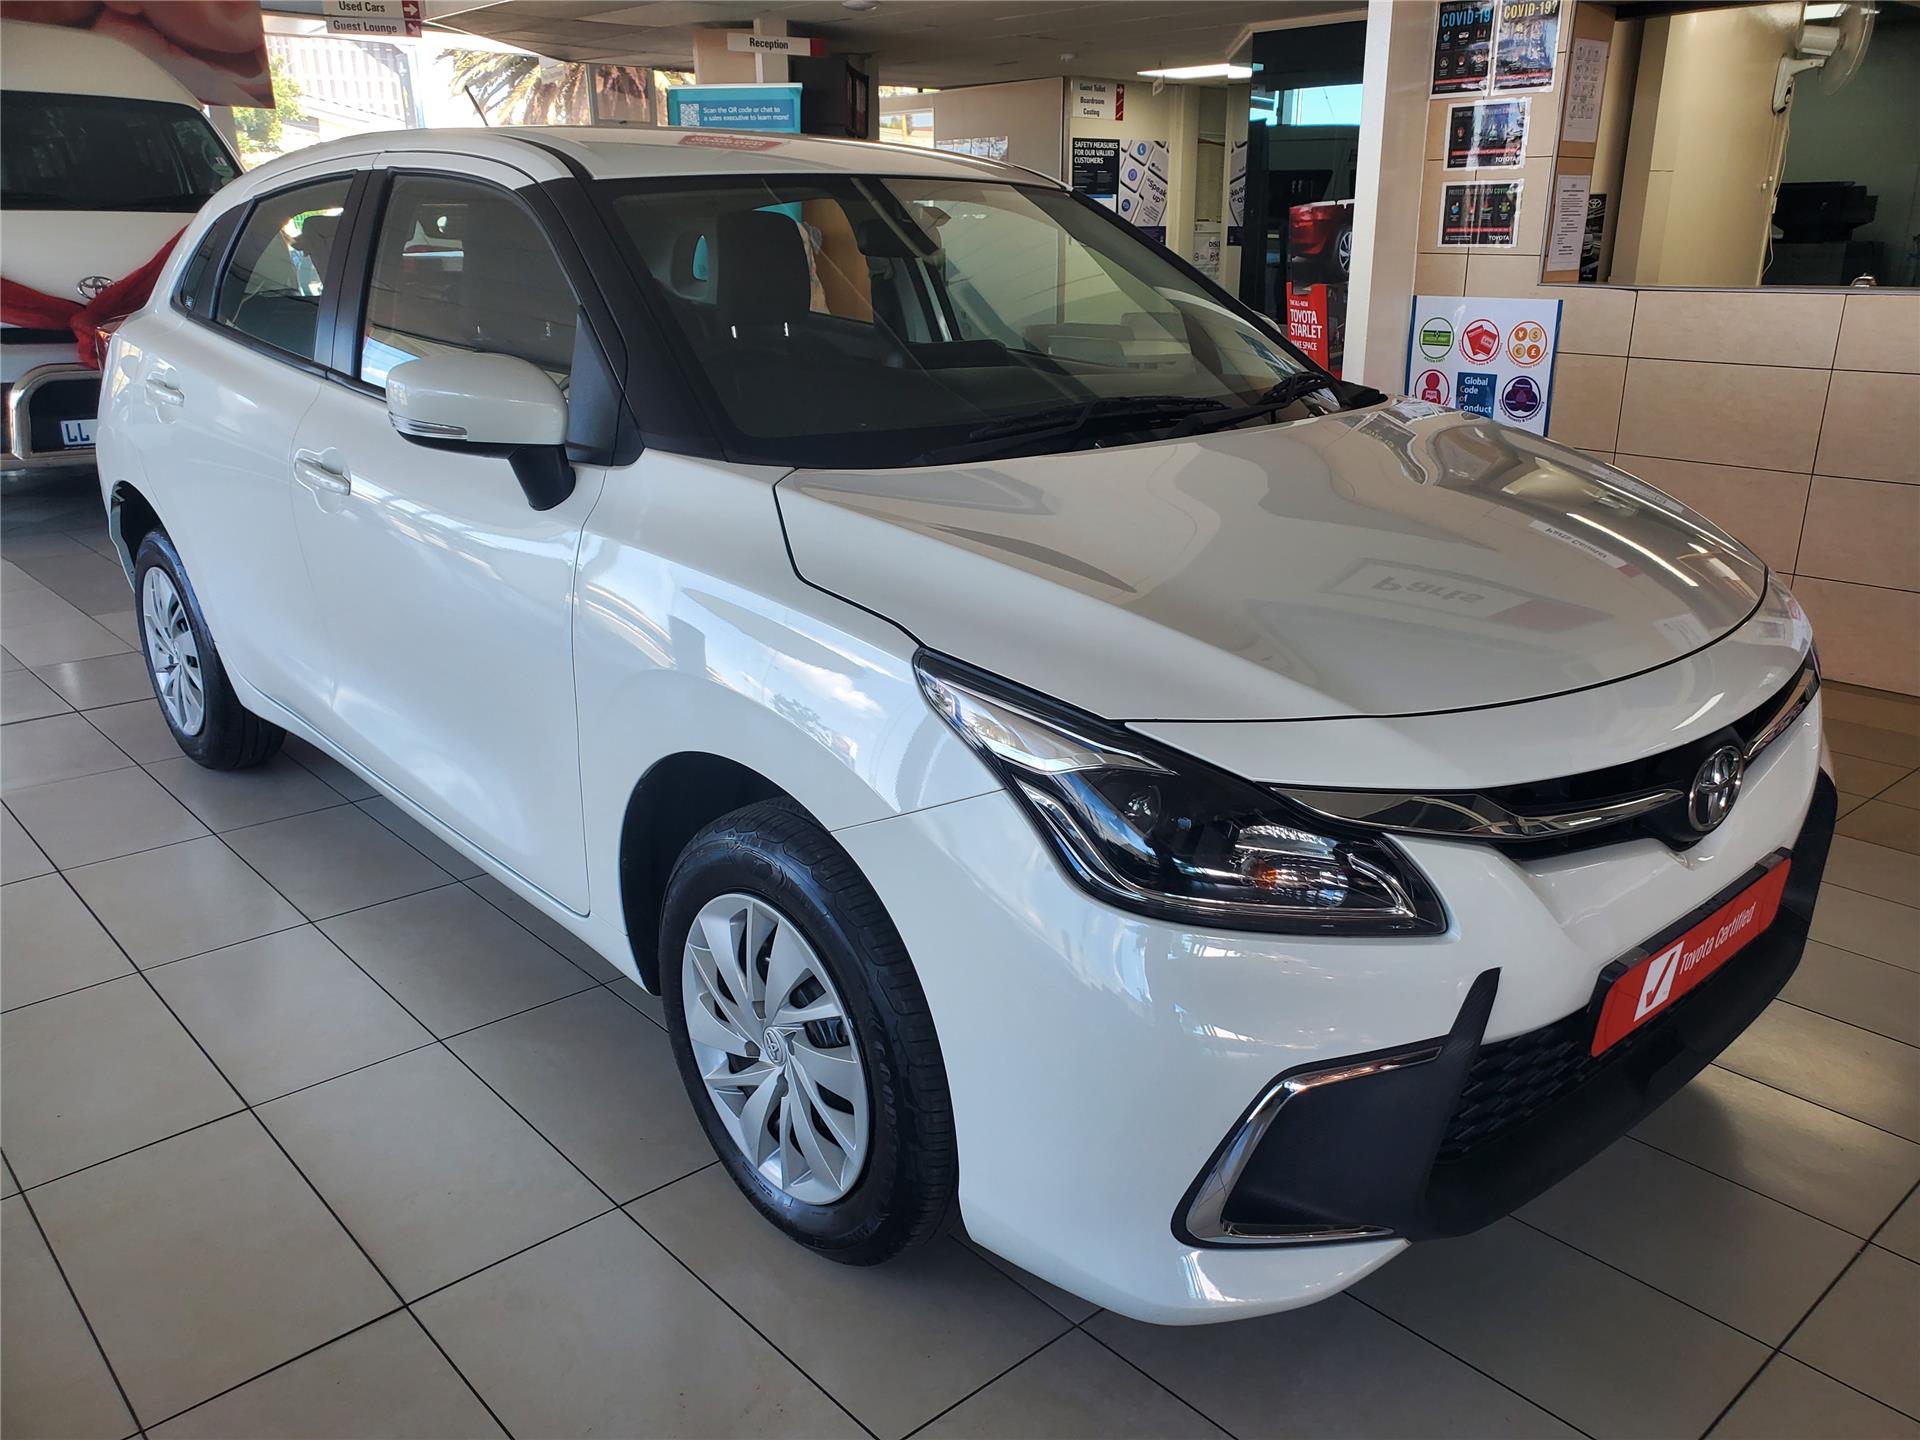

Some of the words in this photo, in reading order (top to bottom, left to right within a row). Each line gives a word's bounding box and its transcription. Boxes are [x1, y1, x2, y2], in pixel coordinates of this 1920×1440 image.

[339, 1, 362, 11] Used
[365, 2, 386, 13] Cars
[1442, 8, 1491, 28] COVID-19
[334, 20, 361, 31] Guest
[364, 22, 398, 34] Lounge
[749, 37, 789, 50] Reception
[1080, 96, 1105, 105] Boardroom
[718, 106, 727, 114] the
[728, 106, 738, 114] QR
[1083, 108, 1100, 117] Costing
[1074, 141, 1093, 149] SAFETY
[1290, 308, 1318, 324] TOYOTA
[1290, 323, 1322, 339] STARLET
[1302, 341, 1318, 351] SPACE
[1464, 376, 1489, 386] Global
[1459, 385, 1479, 395] Code
[1459, 394, 1468, 402] of
[65, 423, 91, 442] LL
[1679, 936, 1715, 975] Toyota
[1715, 902, 1757, 949] Certified
